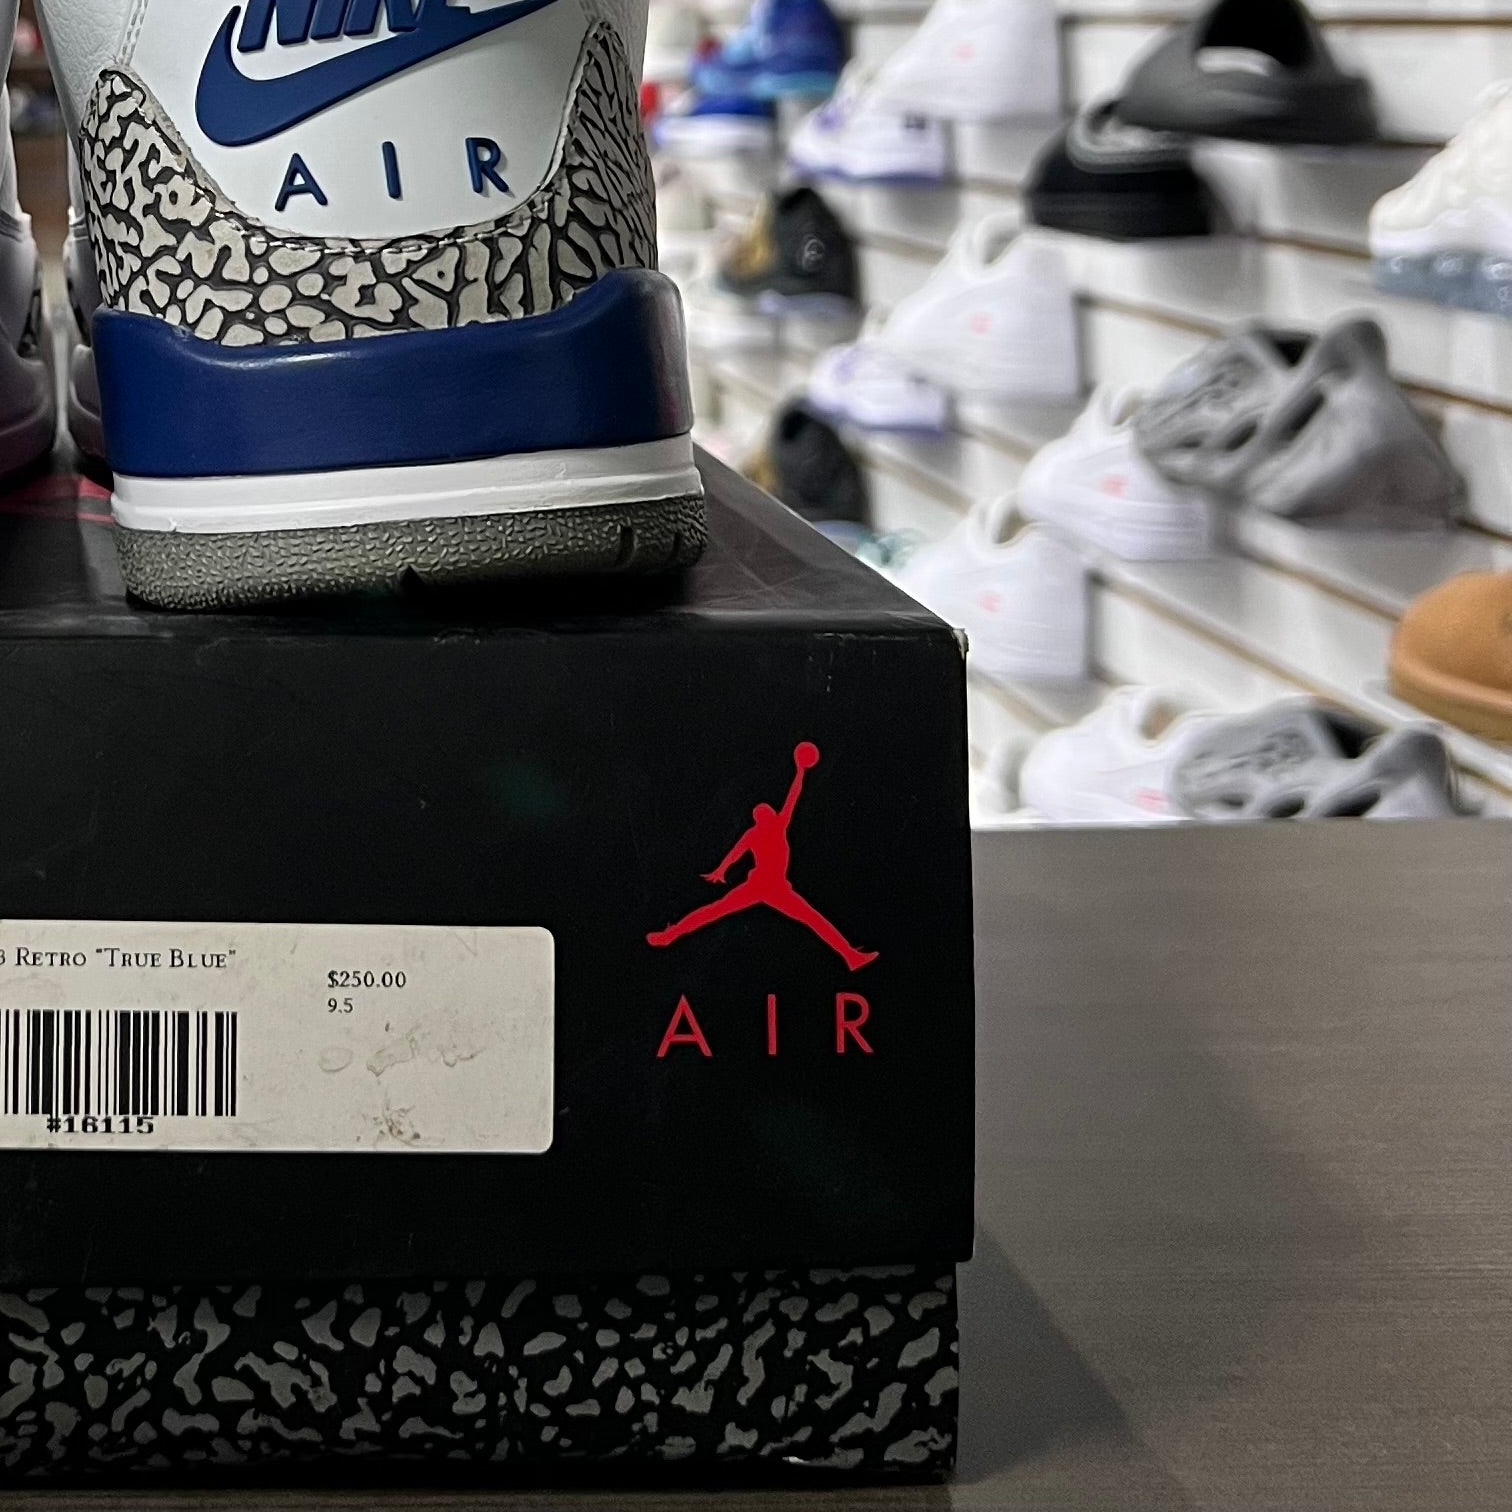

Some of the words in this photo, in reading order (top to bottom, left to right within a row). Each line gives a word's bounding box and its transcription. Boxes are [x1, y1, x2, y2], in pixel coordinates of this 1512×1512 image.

[273, 137, 510, 212] AIR
[327, 969, 407, 989] $250.00
[327, 997, 354, 1014] 9.5
[655, 991, 875, 1058] AIR
[46, 1115, 155, 1134] #16115
